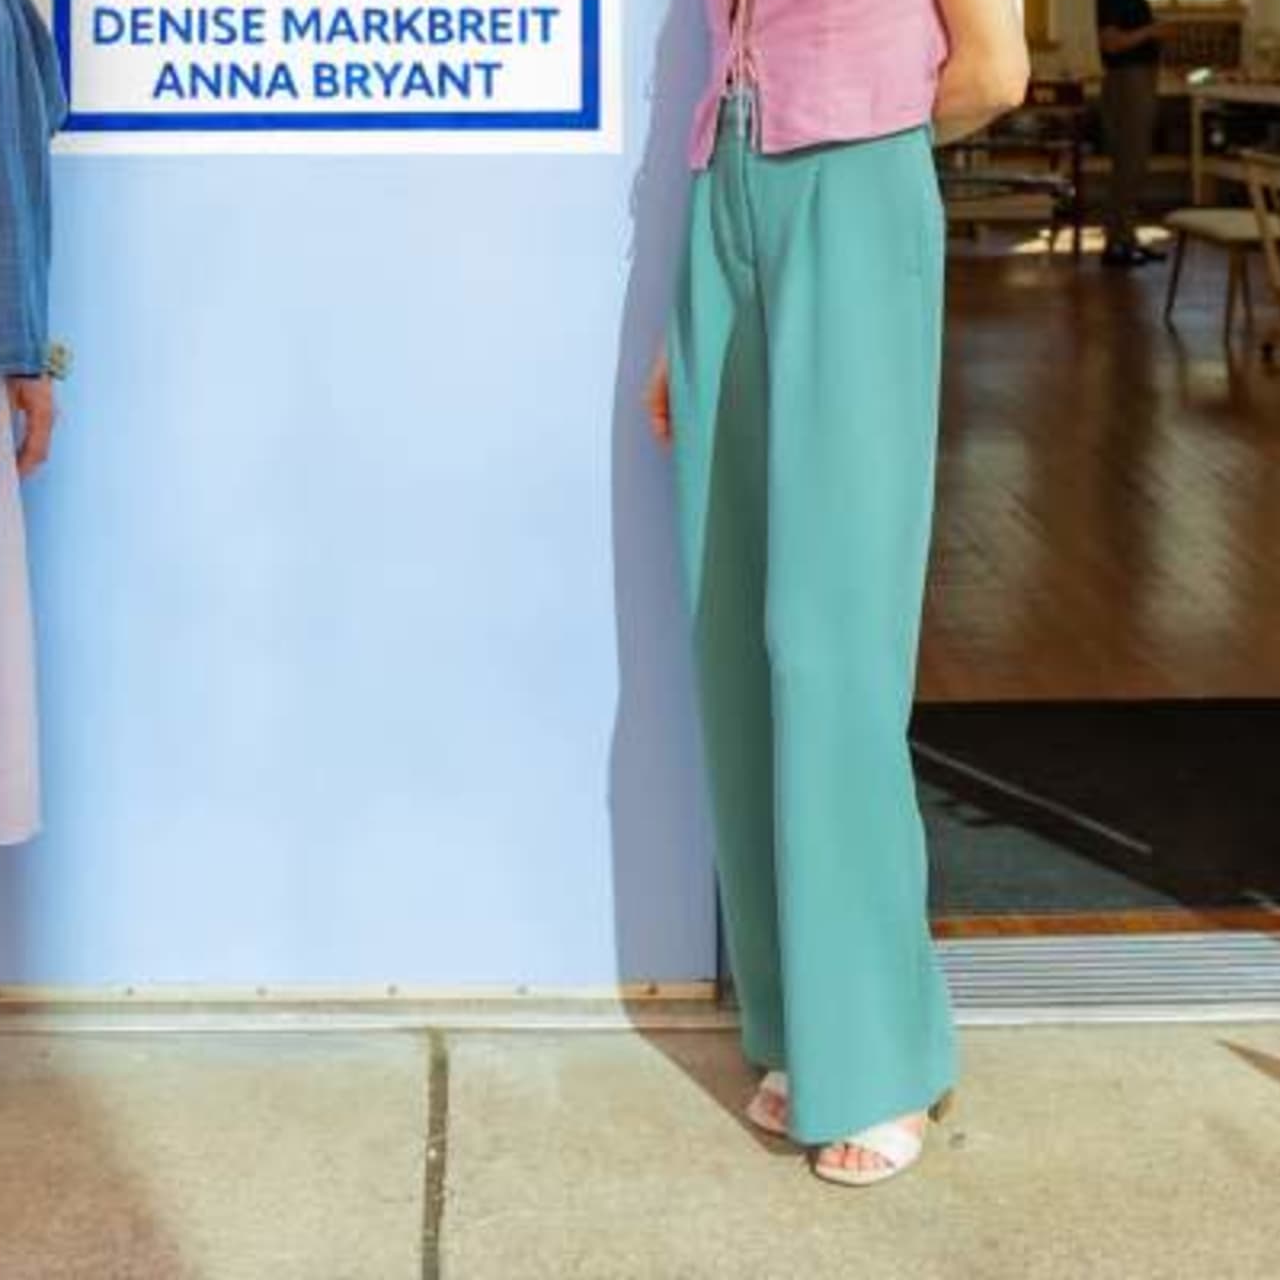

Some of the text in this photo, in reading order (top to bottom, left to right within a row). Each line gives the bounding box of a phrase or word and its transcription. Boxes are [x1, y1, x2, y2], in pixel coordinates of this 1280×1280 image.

[93, 7, 561, 44] DENISE MARKBREIT
[152, 62, 503, 99] ANNA BRYANT
